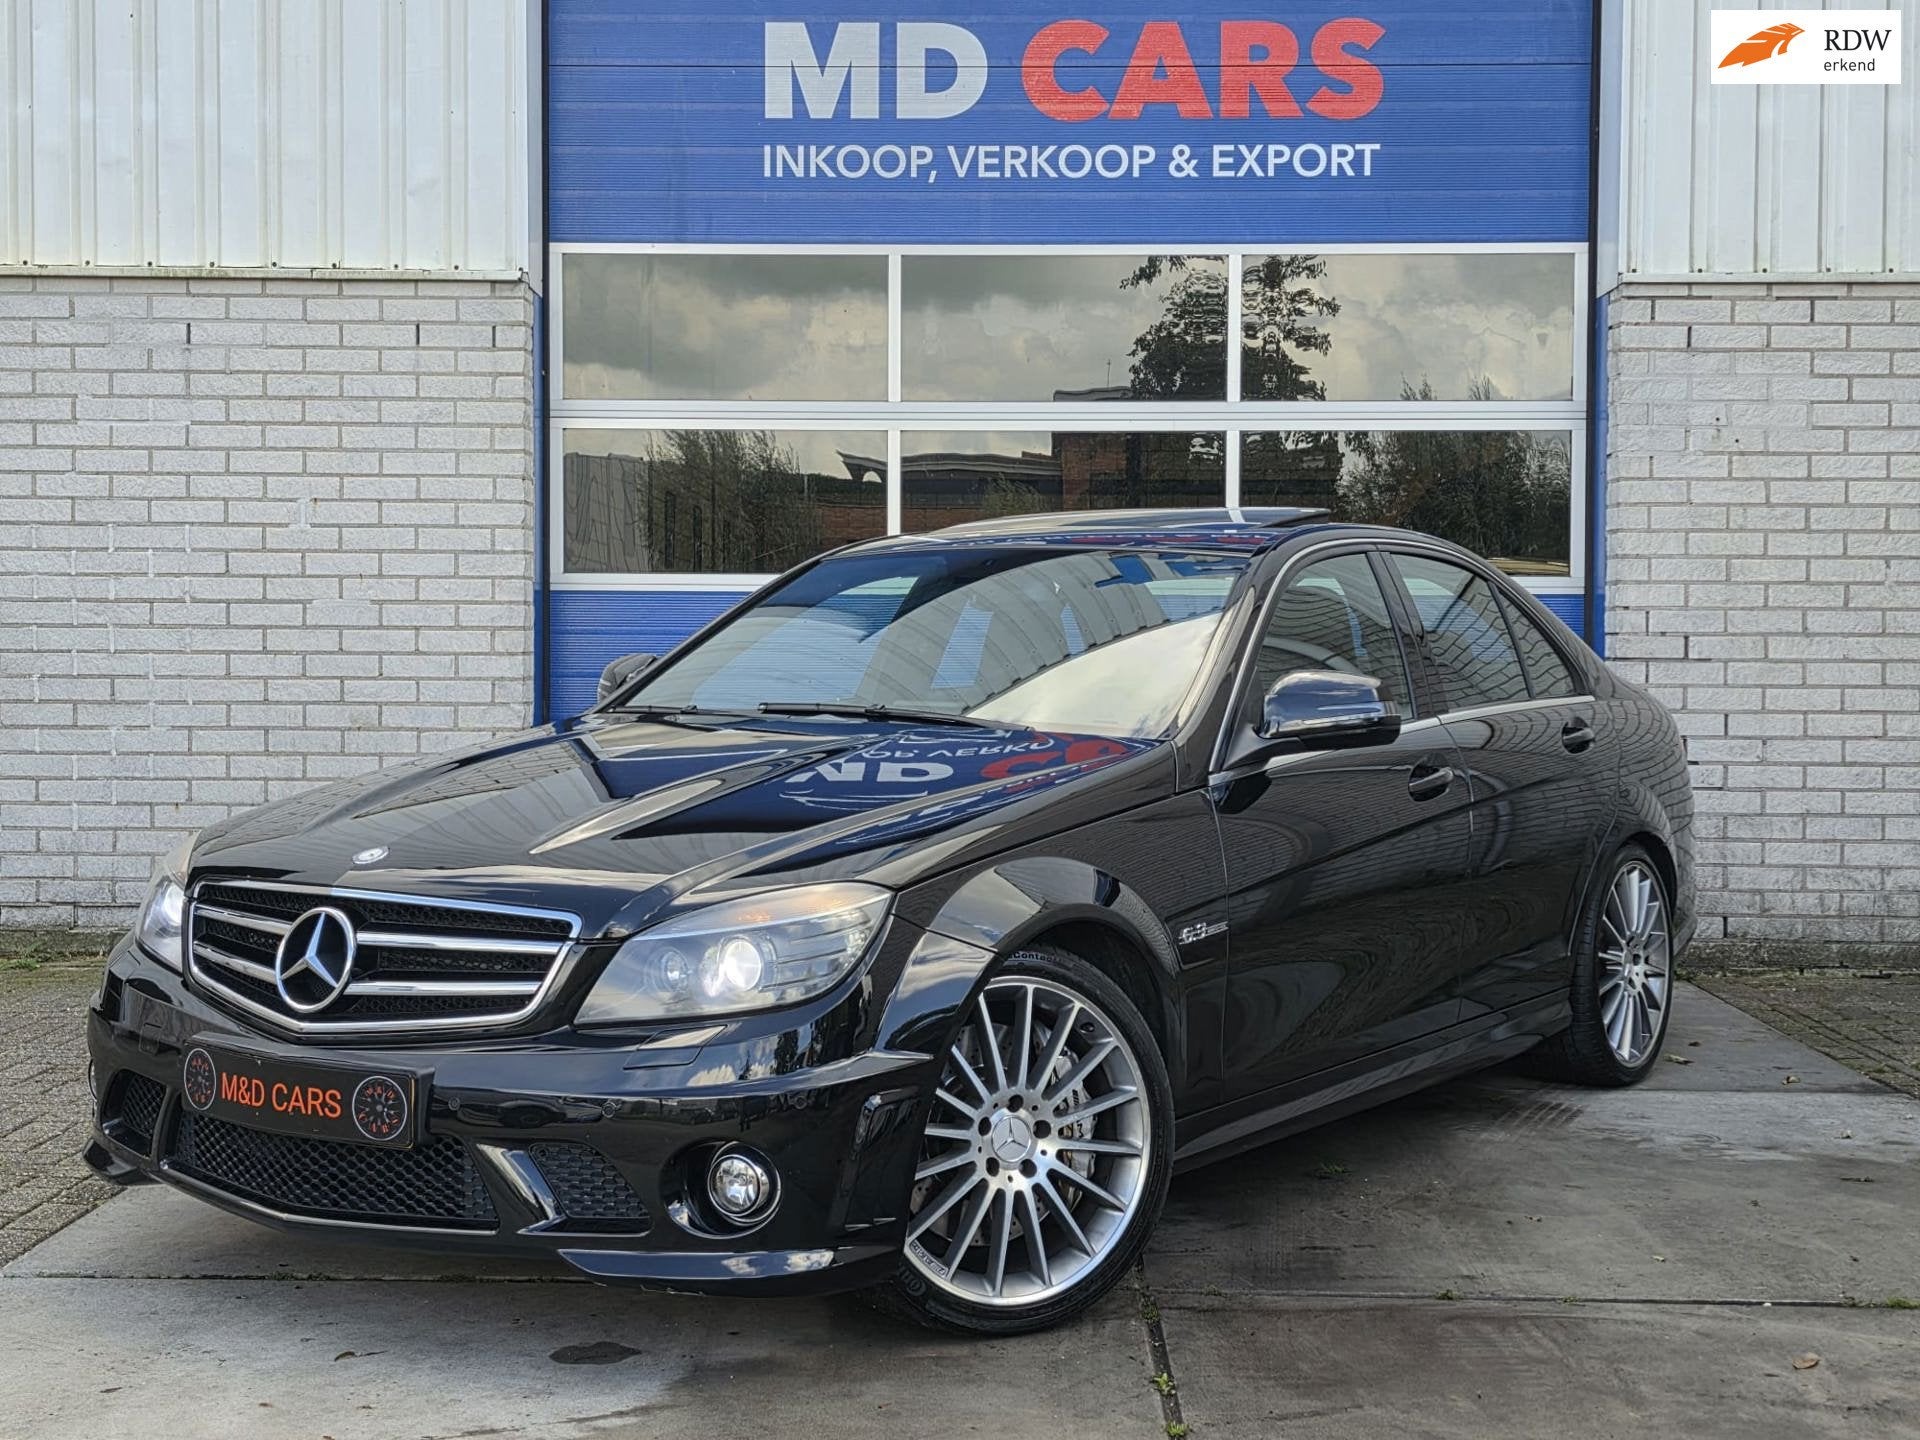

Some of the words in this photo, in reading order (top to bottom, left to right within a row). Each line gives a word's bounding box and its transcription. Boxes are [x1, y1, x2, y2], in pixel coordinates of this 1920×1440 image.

[764, 22, 988, 119] MD
[1021, 18, 1386, 121] CARS
[763, 144, 937, 183] INKOOP,
[947, 144, 1156, 178] VERKOOP
[1168, 145, 1199, 178] &
[1213, 143, 1381, 177] EXPORT
[221, 1072, 265, 1107] M&D
[271, 1083, 342, 1118] CARS
